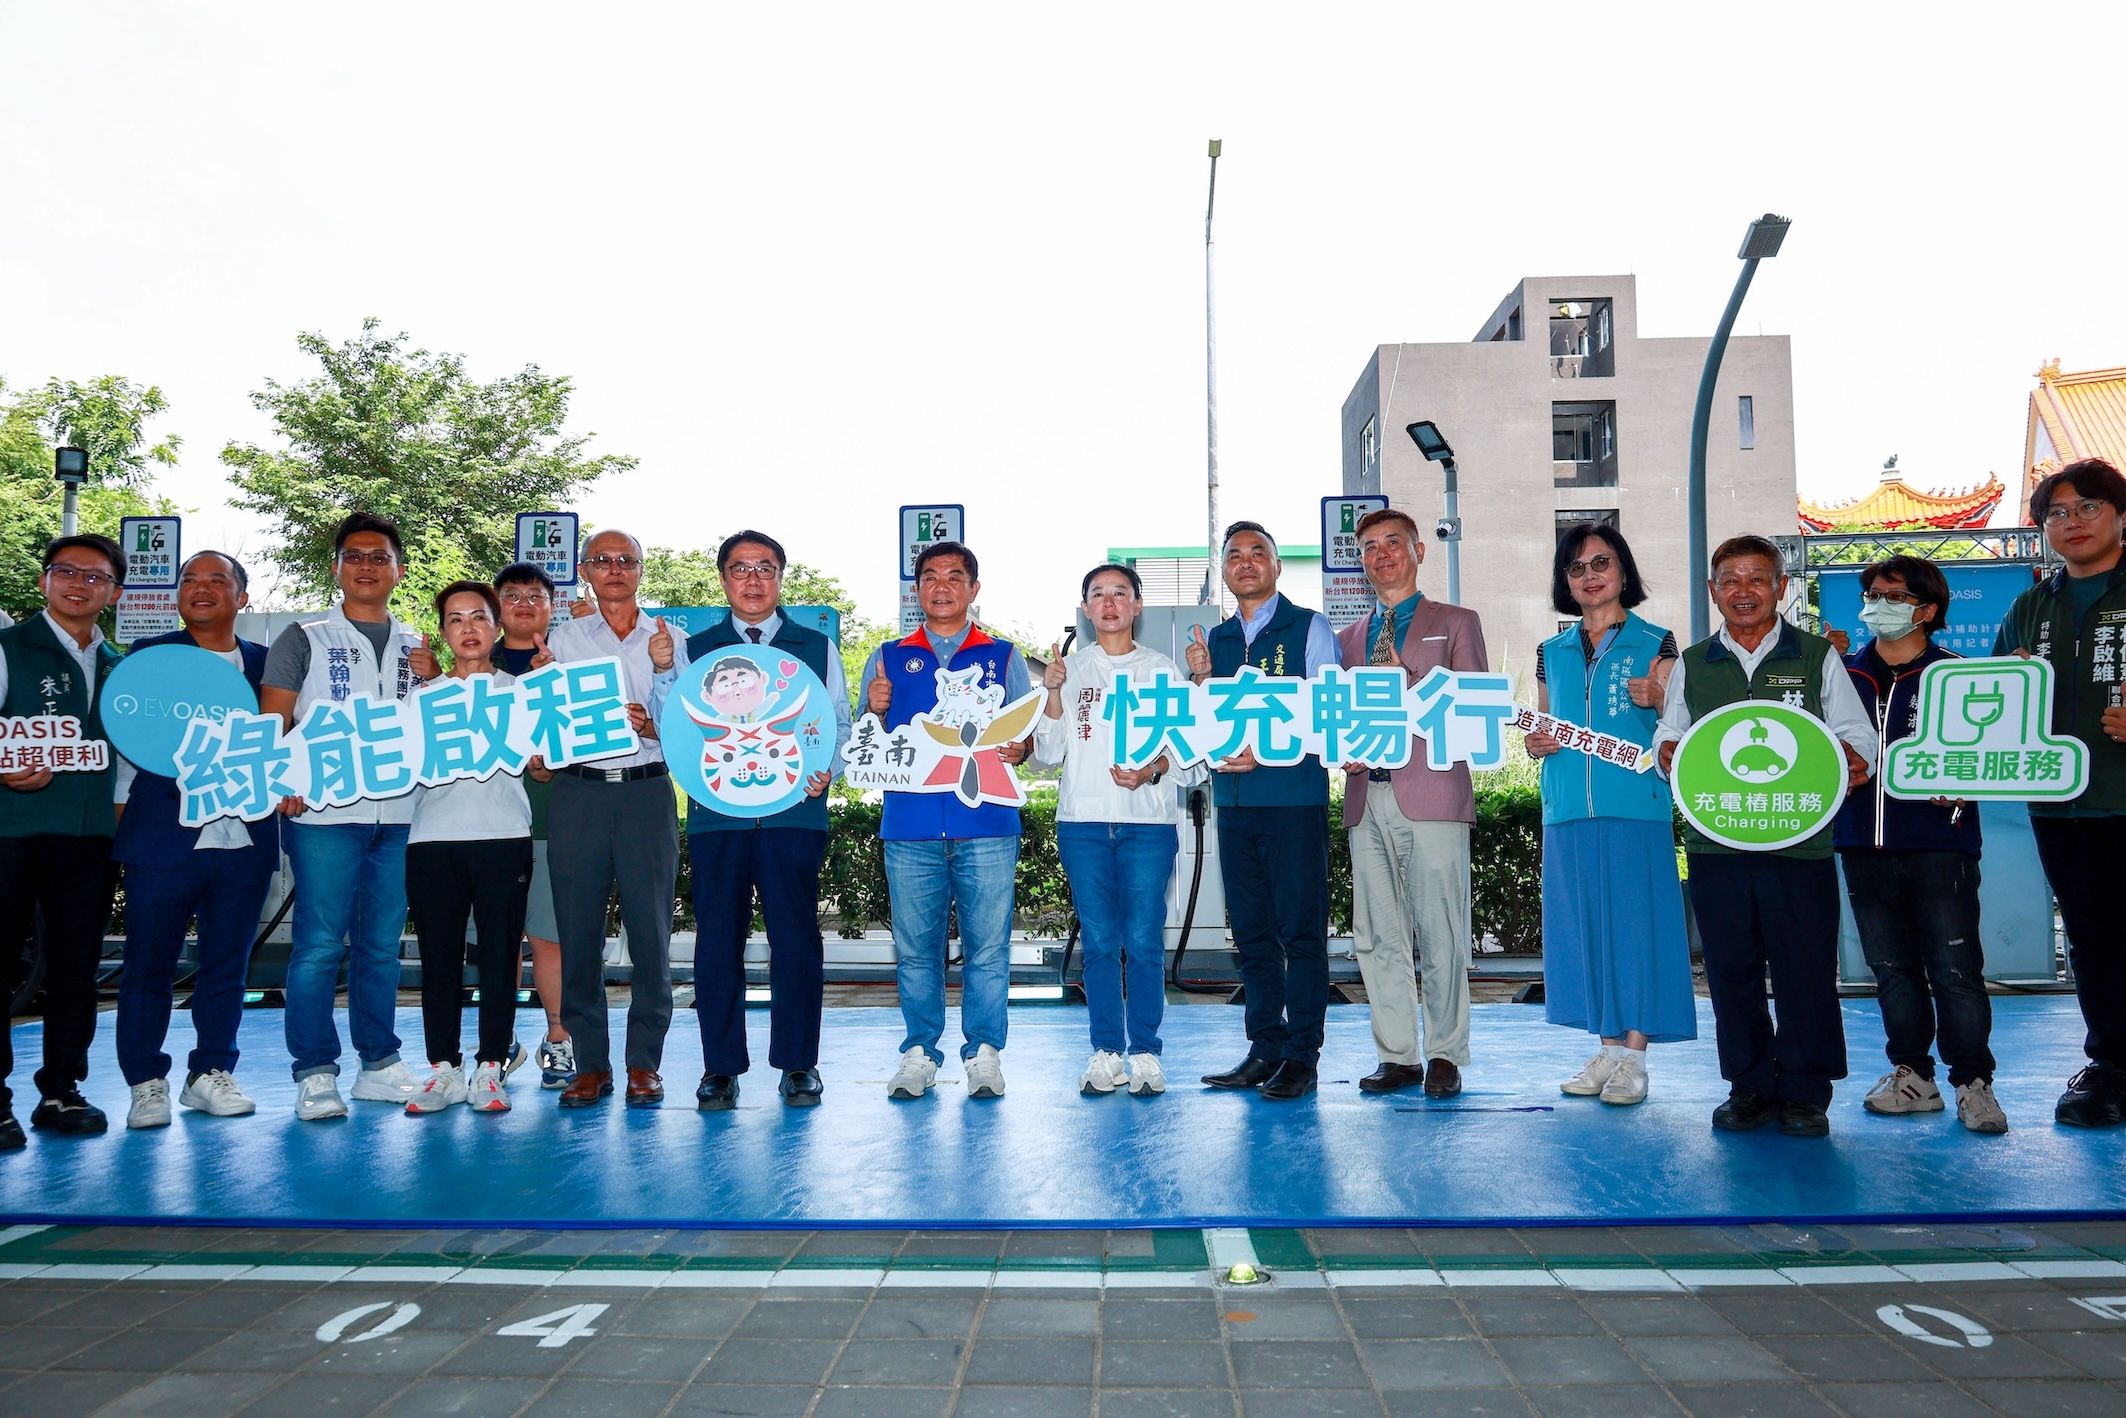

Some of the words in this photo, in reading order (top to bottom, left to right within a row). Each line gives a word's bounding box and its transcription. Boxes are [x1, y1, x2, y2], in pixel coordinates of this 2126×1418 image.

[129, 554, 170, 564] 電動汽車
[525, 551, 567, 560] 電動汽車
[129, 566, 170, 576] 充電專用
[1103, 670, 1513, 765] 快充暢行
[183, 661, 633, 822] 綠能啟程
[848, 719, 917, 768] 臺南
[1515, 708, 1640, 767] 造臺南充電網
[1903, 750, 2064, 781] 充電服務
[852, 771, 911, 785] TAINAN
[1714, 815, 1801, 830] Charging
